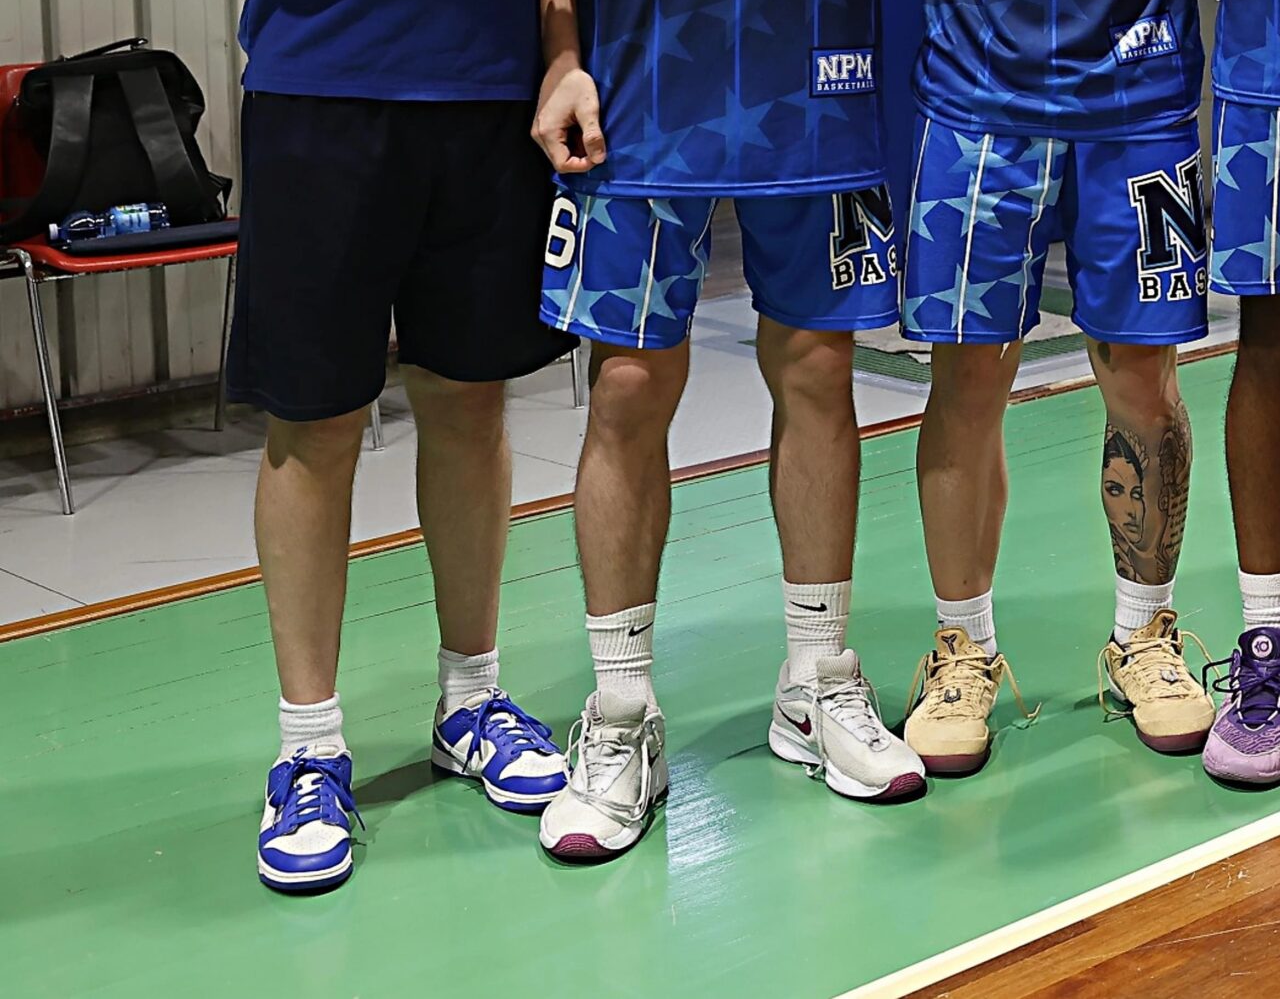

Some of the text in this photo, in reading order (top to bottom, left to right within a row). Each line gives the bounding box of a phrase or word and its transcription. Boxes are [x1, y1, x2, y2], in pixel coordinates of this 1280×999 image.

[816, 52, 872, 83] NPM
[816, 78, 874, 92] BASKETBALL
[544, 196, 578, 269] 6
